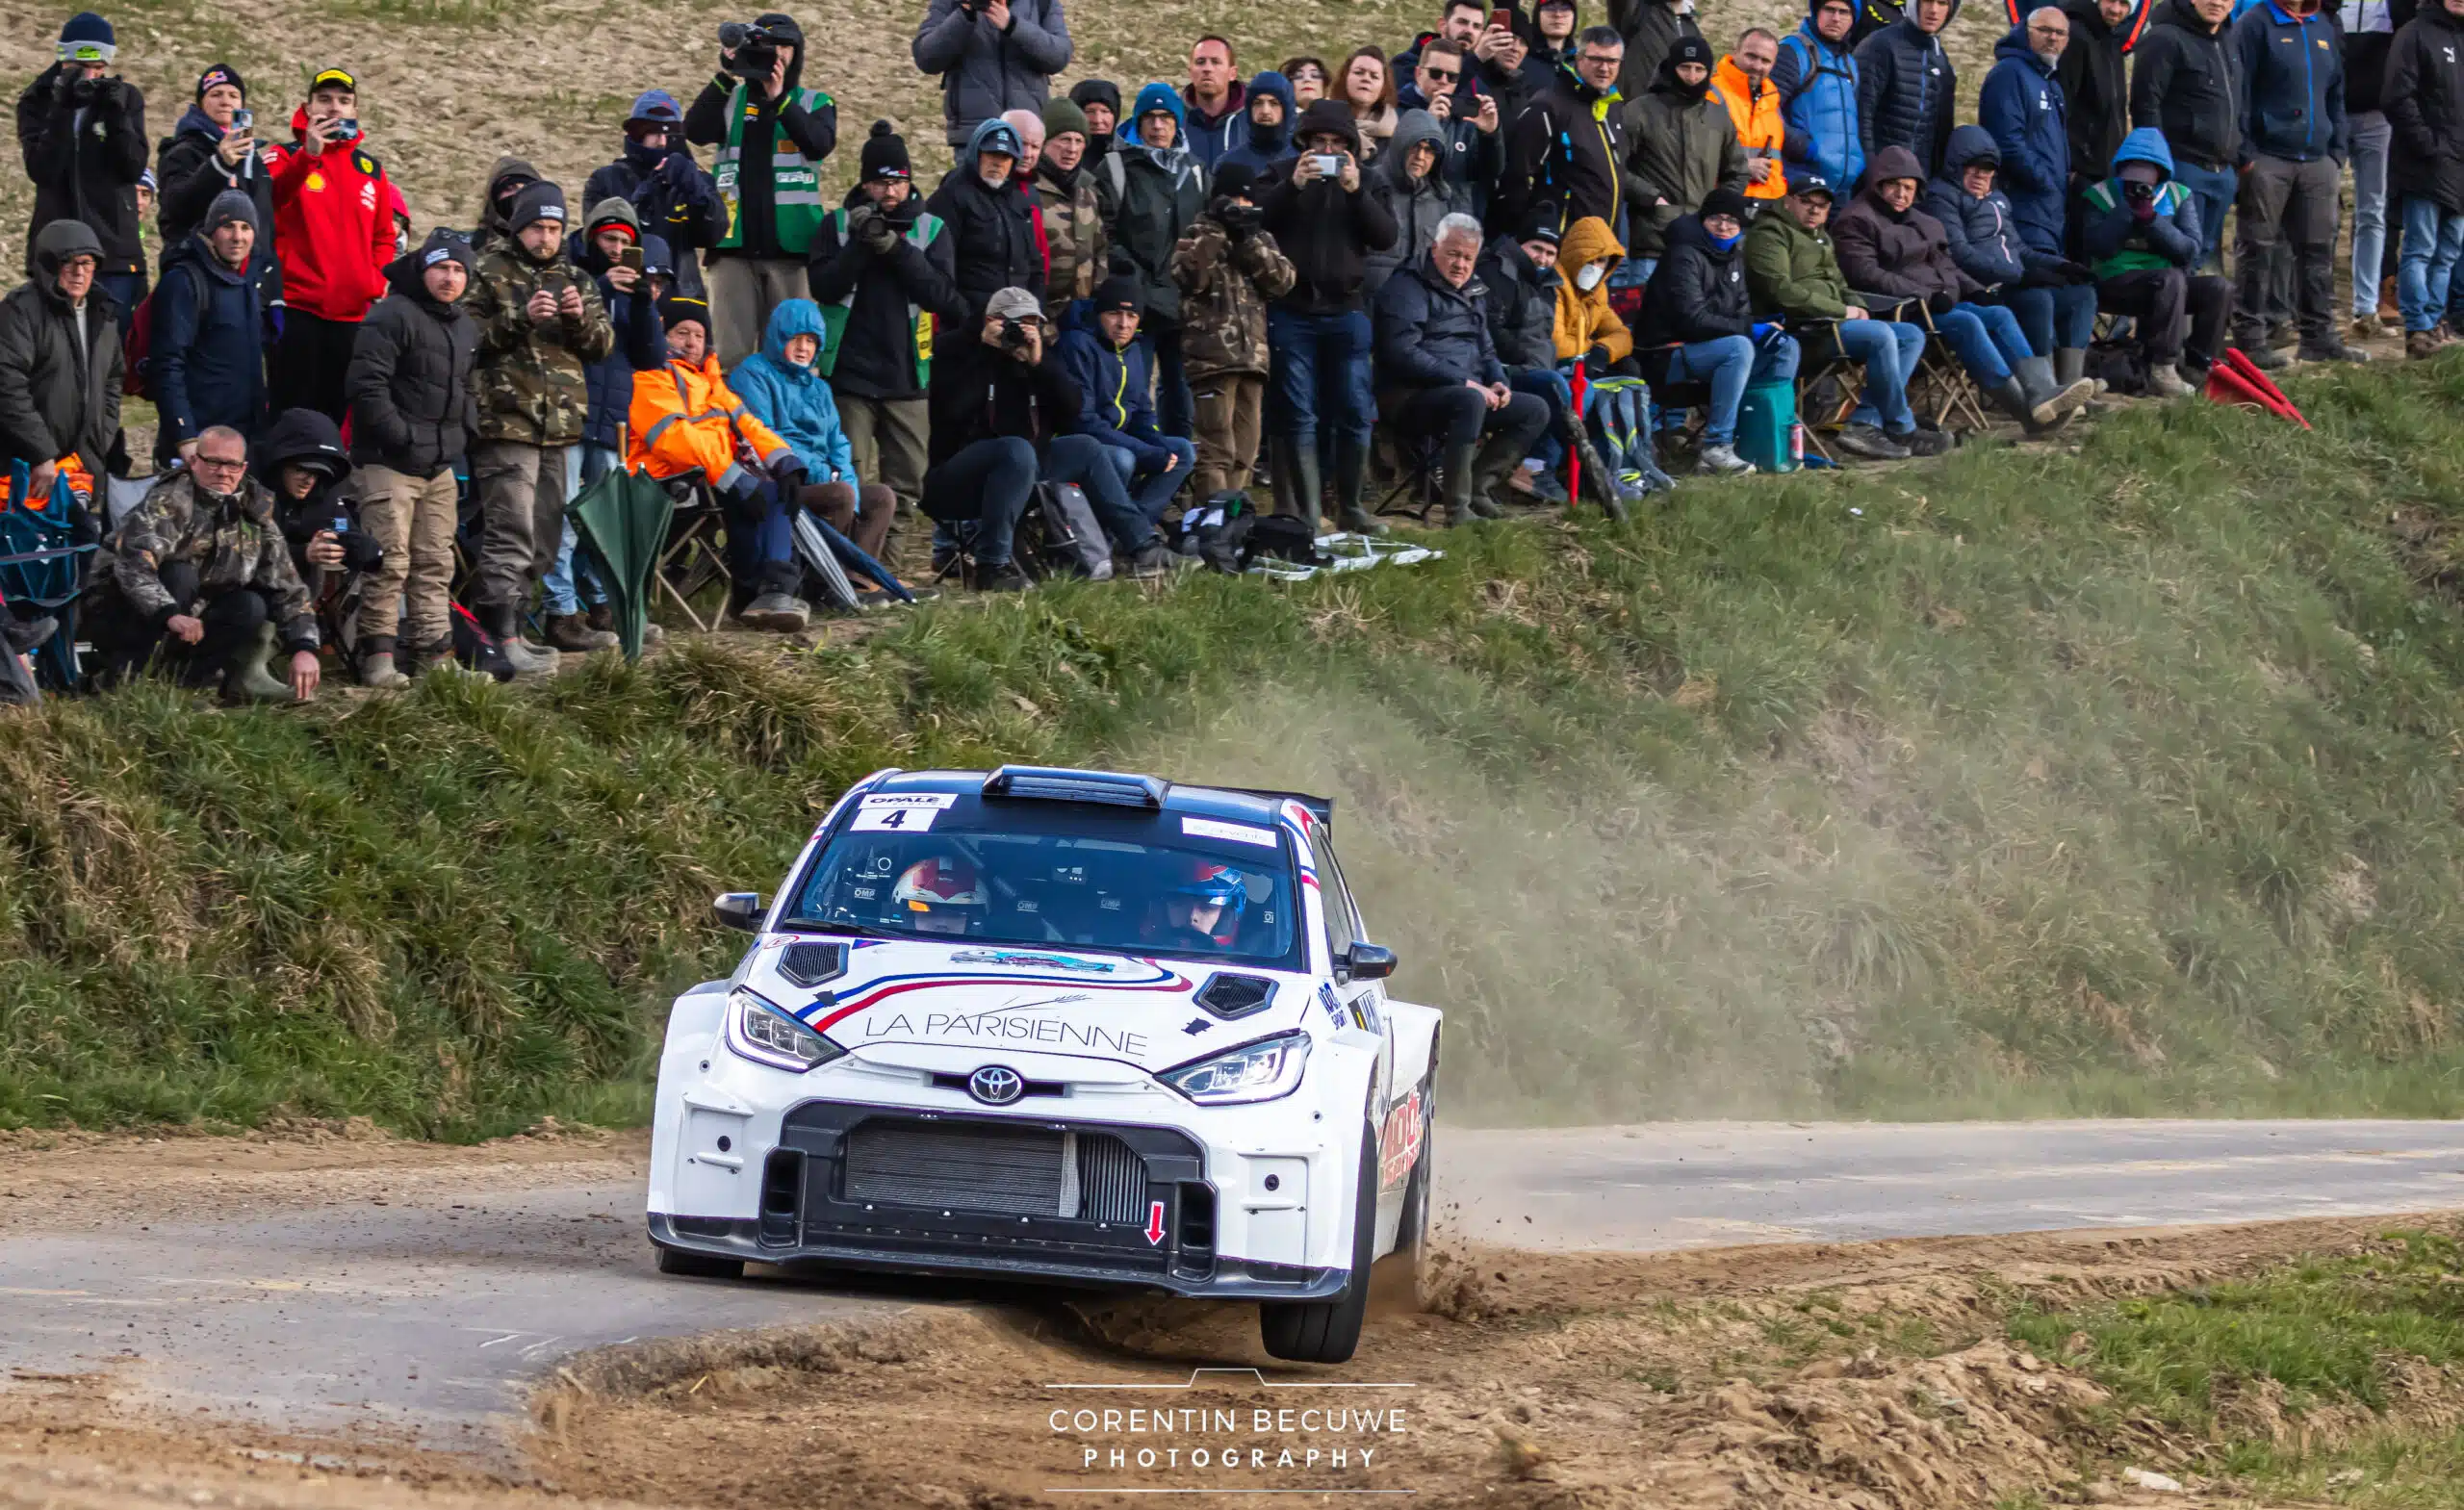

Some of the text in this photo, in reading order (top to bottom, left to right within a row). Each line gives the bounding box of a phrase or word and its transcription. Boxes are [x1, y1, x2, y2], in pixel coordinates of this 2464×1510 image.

[869, 796, 940, 805] OPALE
[881, 809, 907, 829] 4
[854, 888, 875, 898] OMP
[865, 1014, 1147, 1057] LA PARISIENNE
